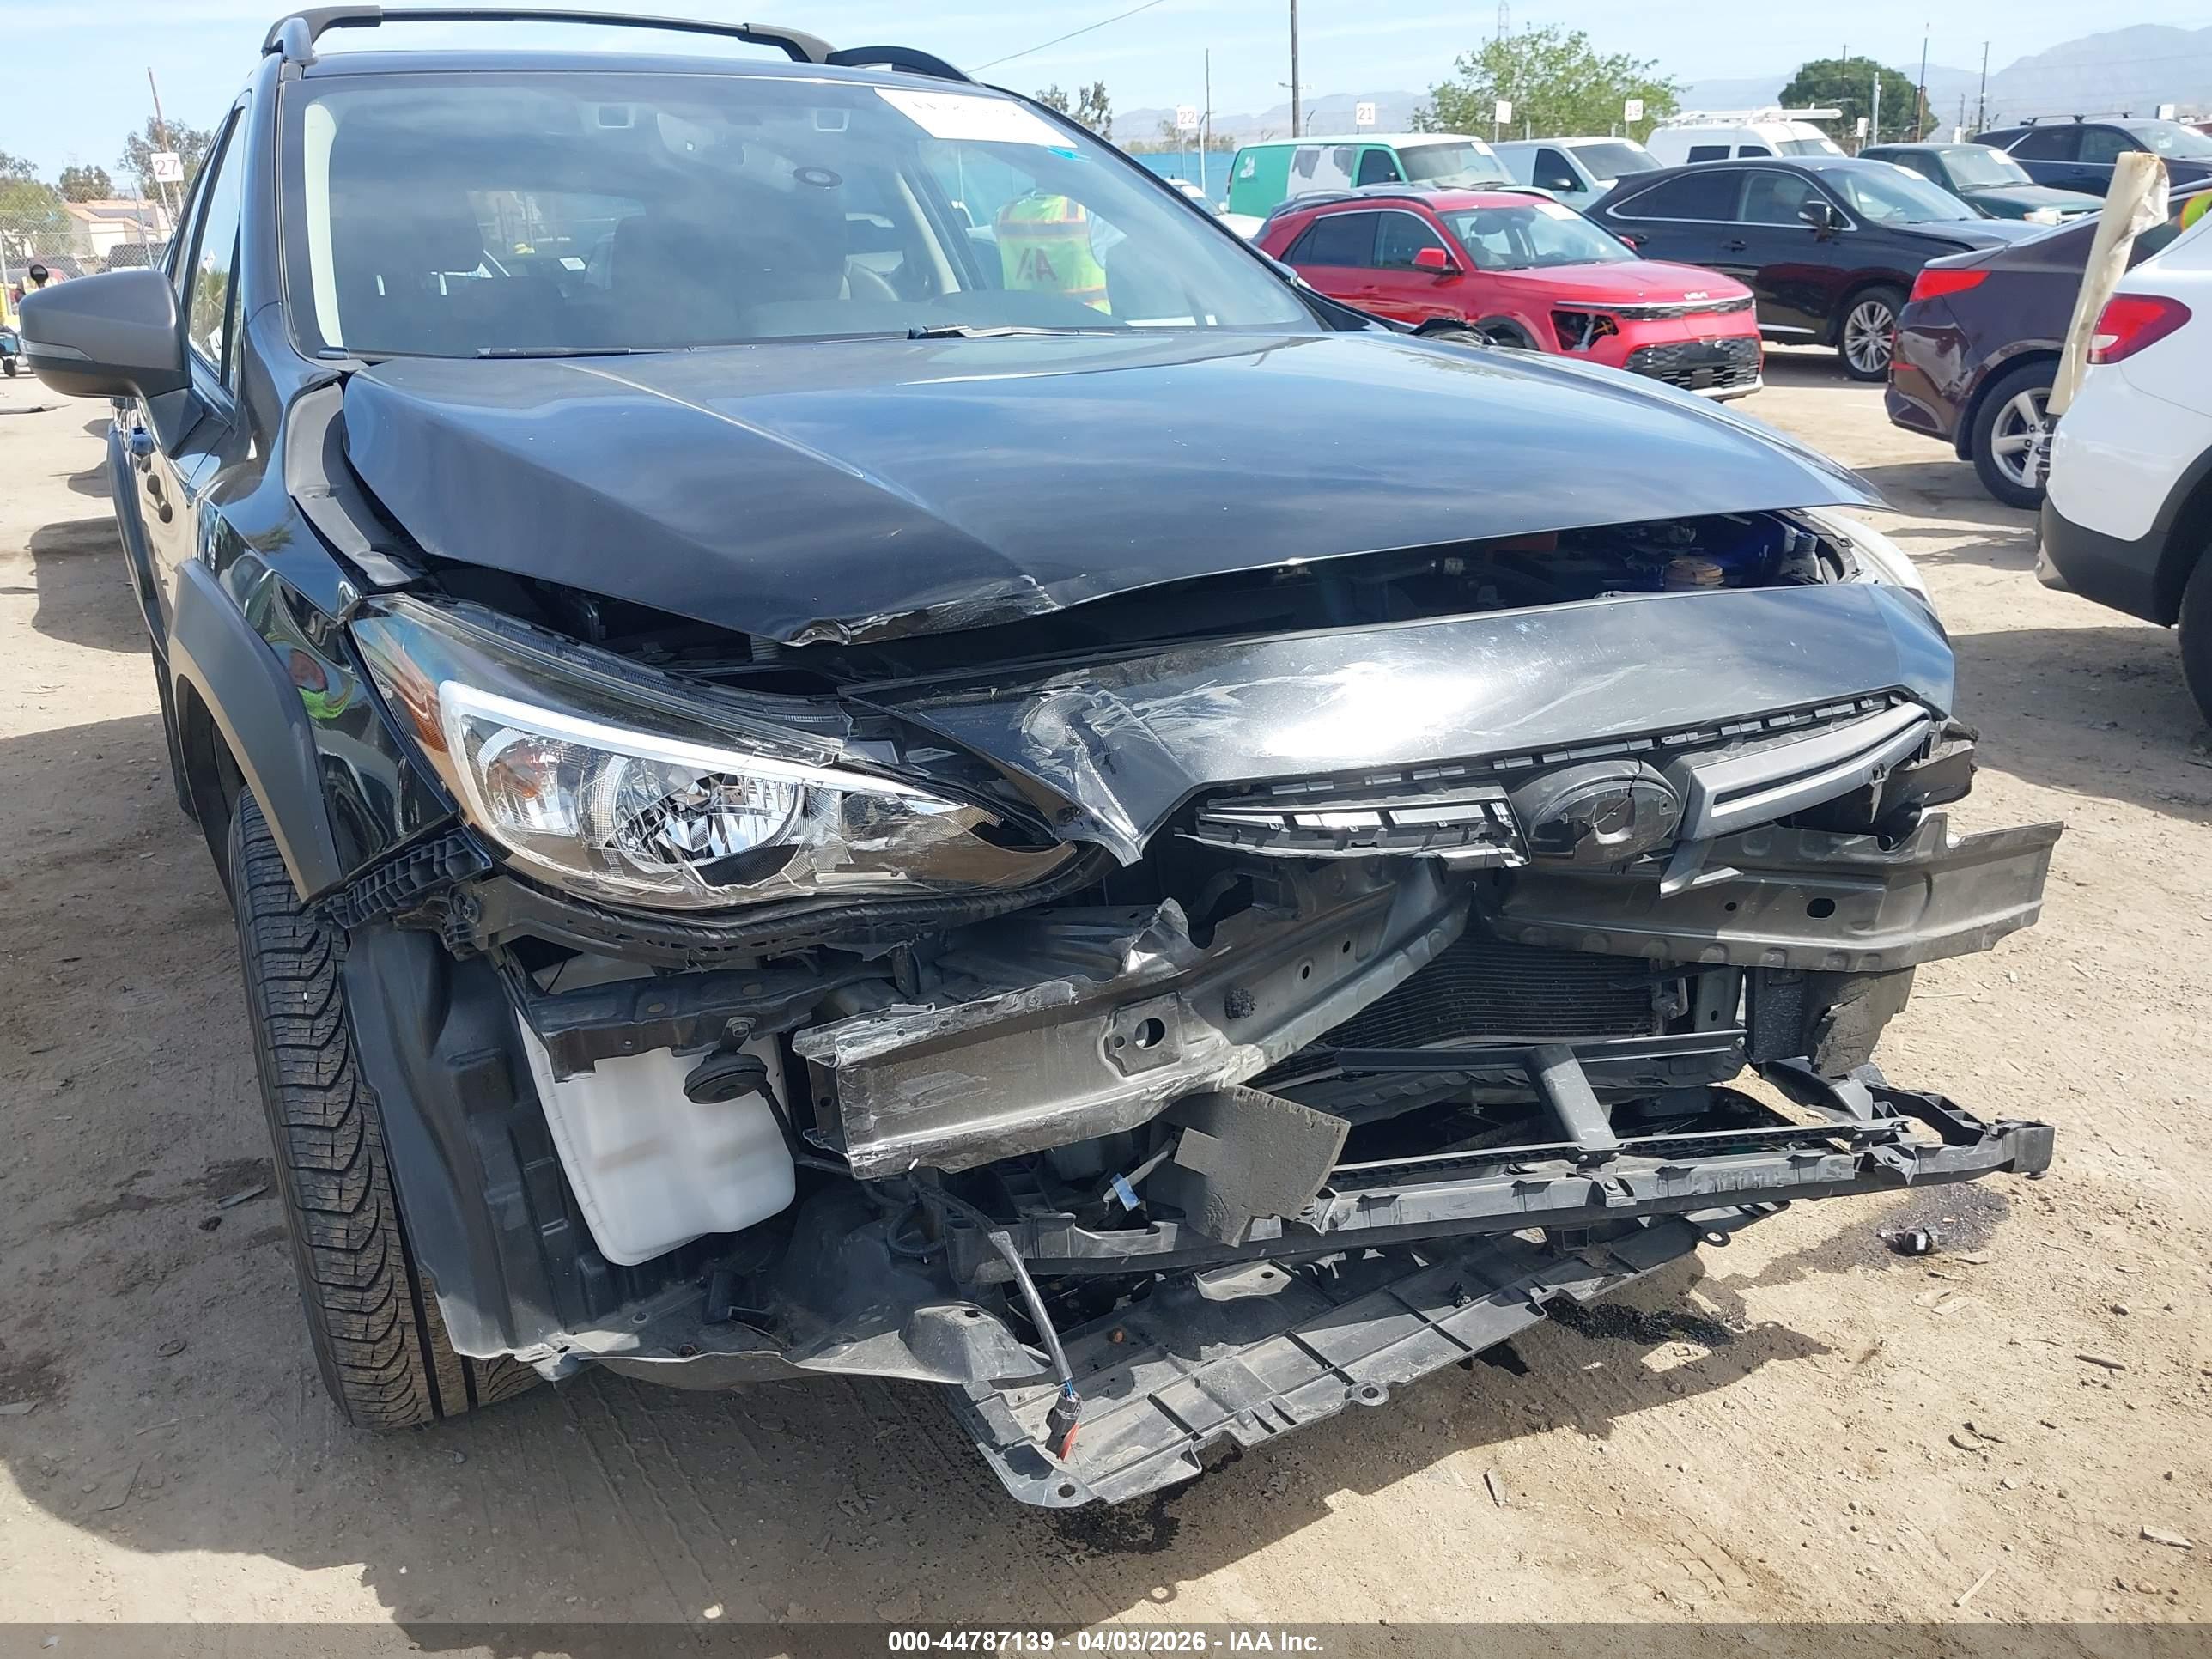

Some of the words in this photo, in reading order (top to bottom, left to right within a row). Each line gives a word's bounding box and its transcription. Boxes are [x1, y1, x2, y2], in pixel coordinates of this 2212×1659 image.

[1179, 112, 1196, 125] 22
[1358, 107, 1372, 120] 21
[155, 159, 179, 176] 27
